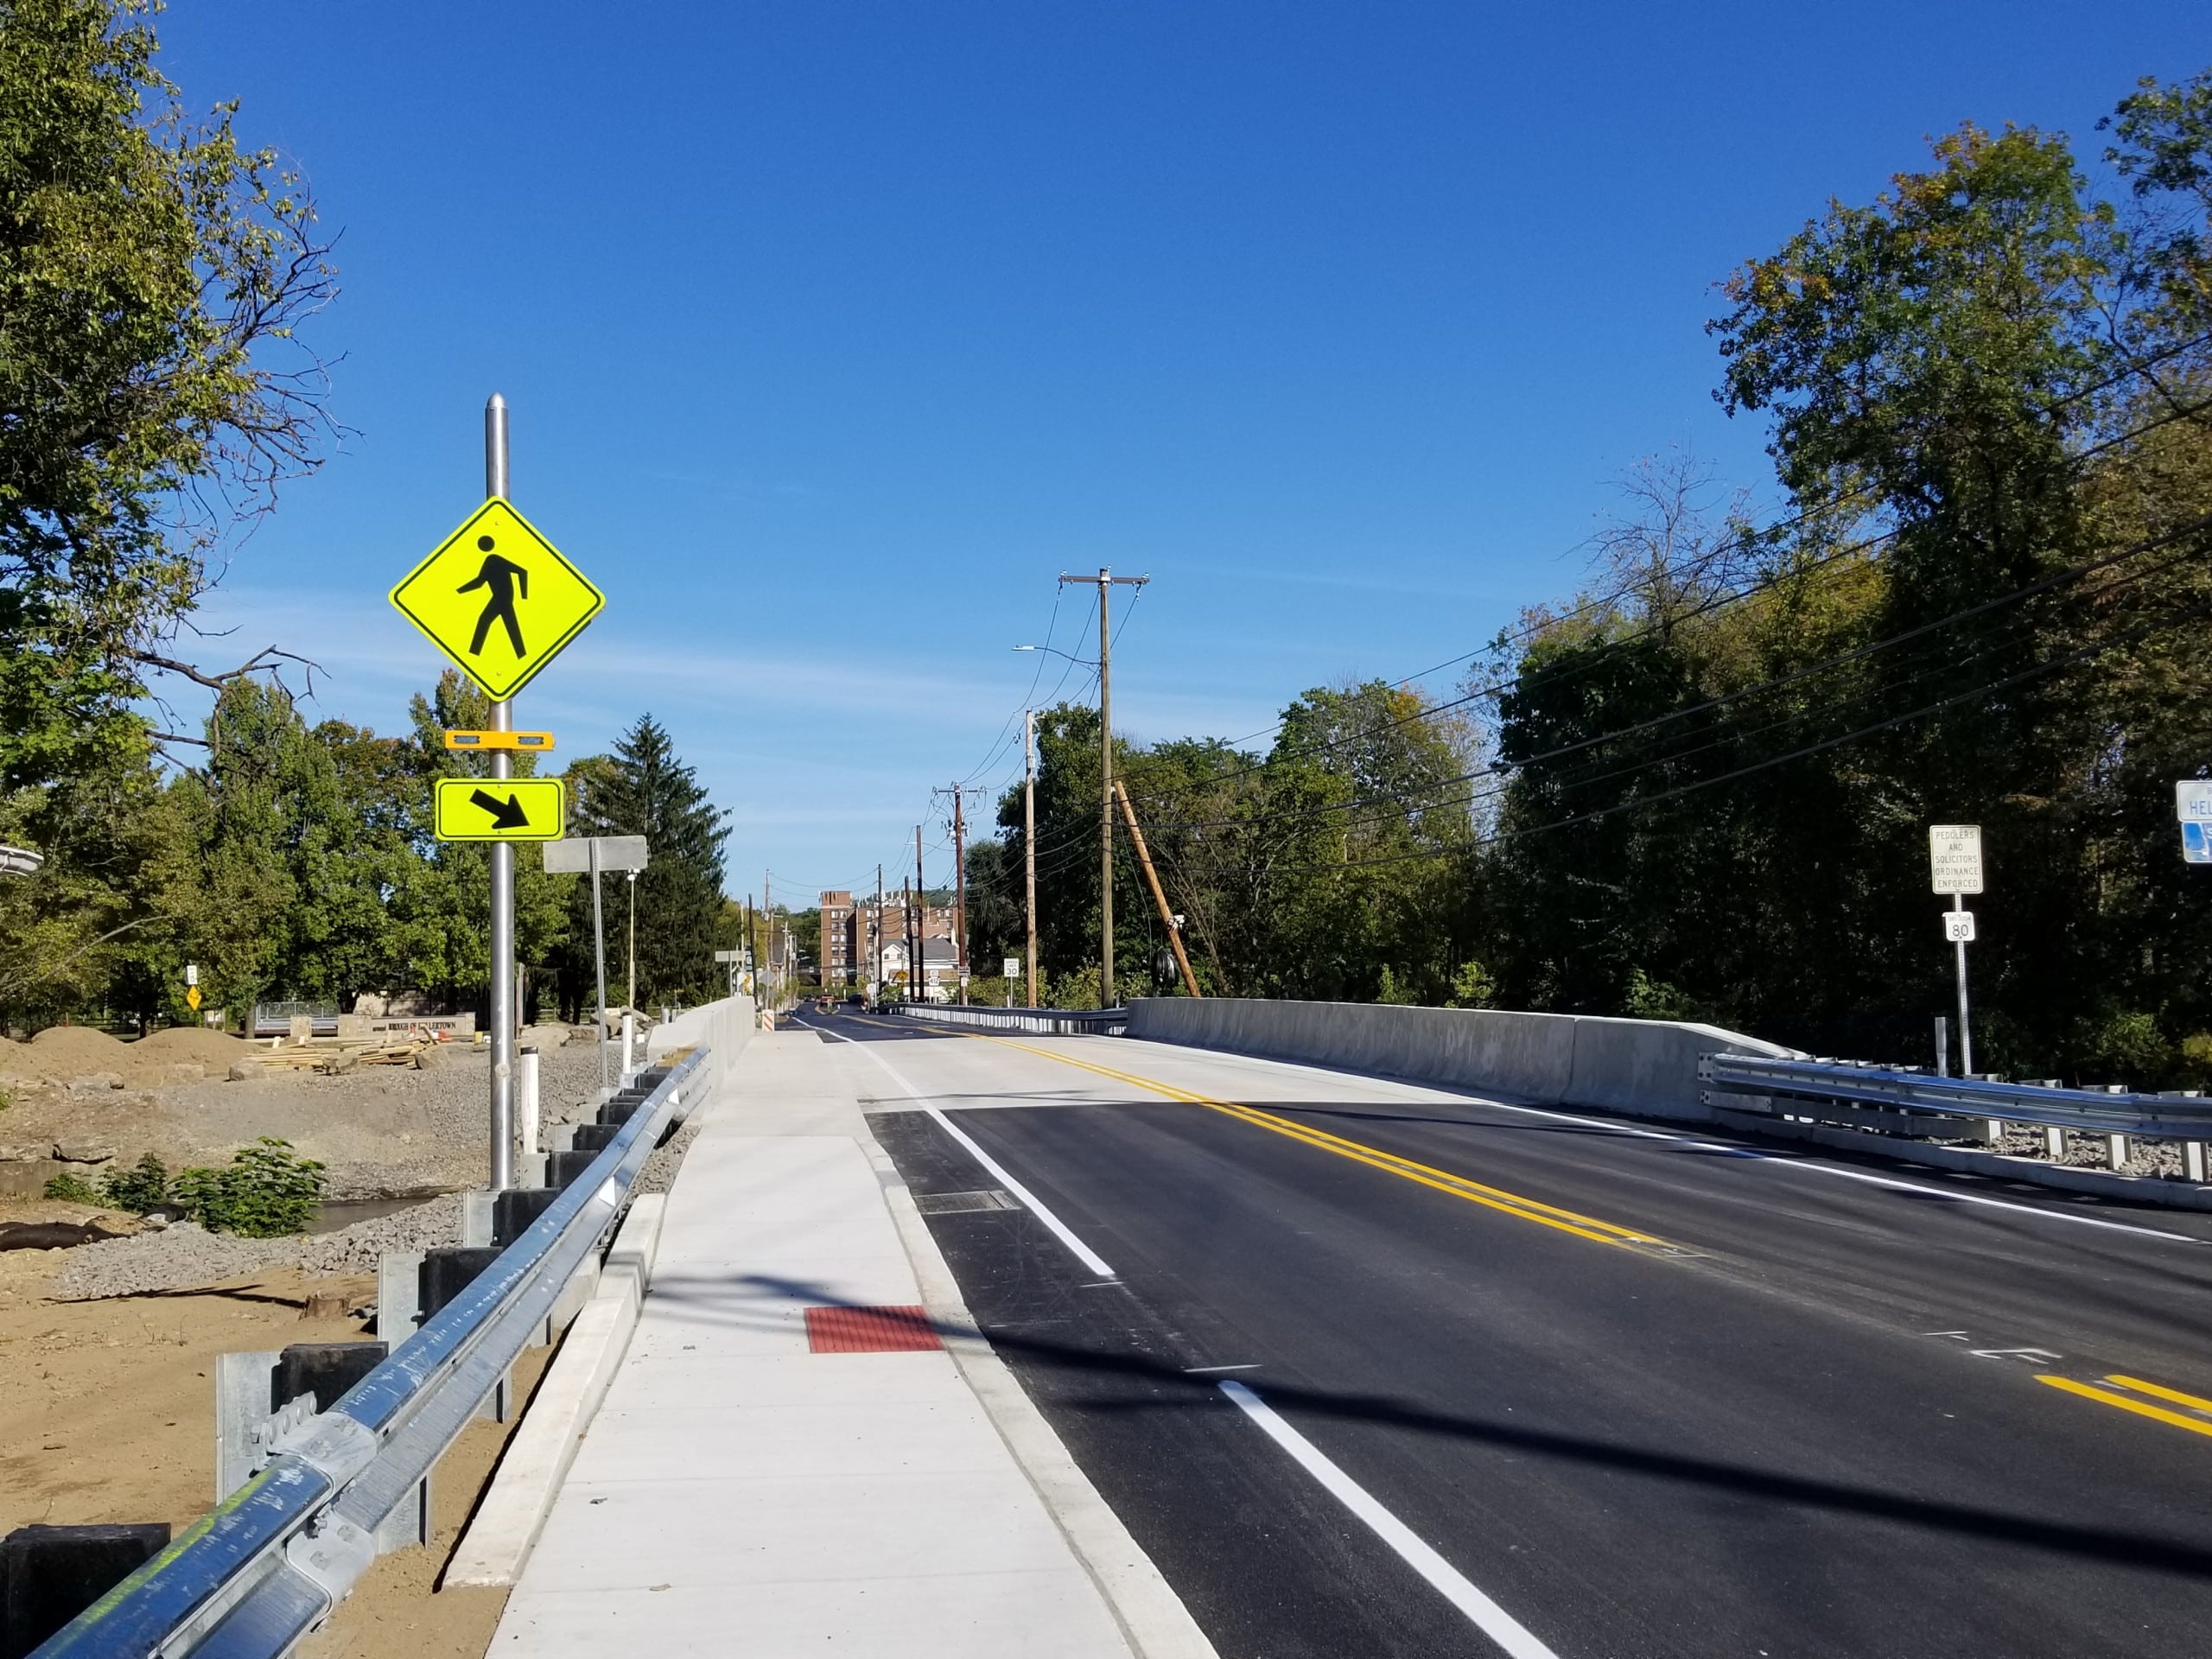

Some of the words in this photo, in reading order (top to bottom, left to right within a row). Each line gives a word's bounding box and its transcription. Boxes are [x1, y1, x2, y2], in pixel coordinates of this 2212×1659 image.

[1936, 830, 1974, 840] PEDDLERS
[1948, 842, 1963, 852] AND
[1935, 855, 1978, 864] SOLICITORS
[1935, 867, 1979, 876] ORDINANCE
[1937, 879, 1978, 888] ENFORCED
[1952, 924, 1969, 937] 80
